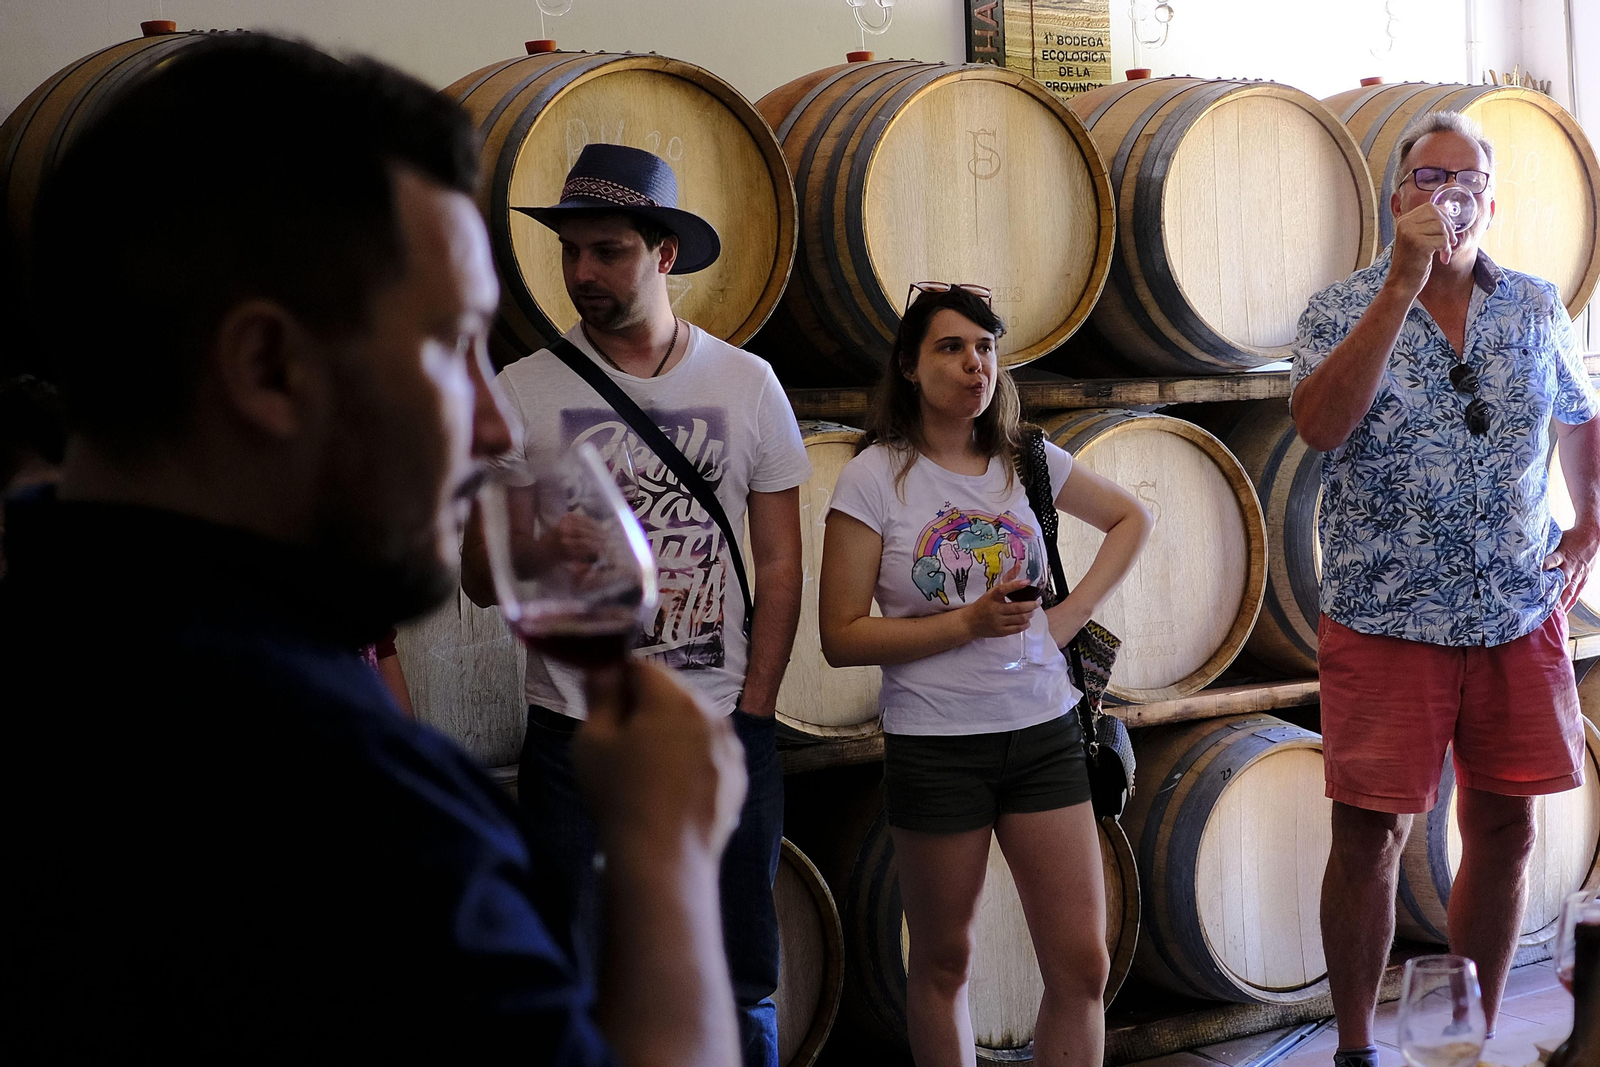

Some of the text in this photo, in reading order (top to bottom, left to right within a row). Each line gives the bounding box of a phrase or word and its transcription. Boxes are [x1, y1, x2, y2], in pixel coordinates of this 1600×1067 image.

[1056, 35, 1104, 47] BODEGA
[1058, 66, 1091, 78] DE LA
